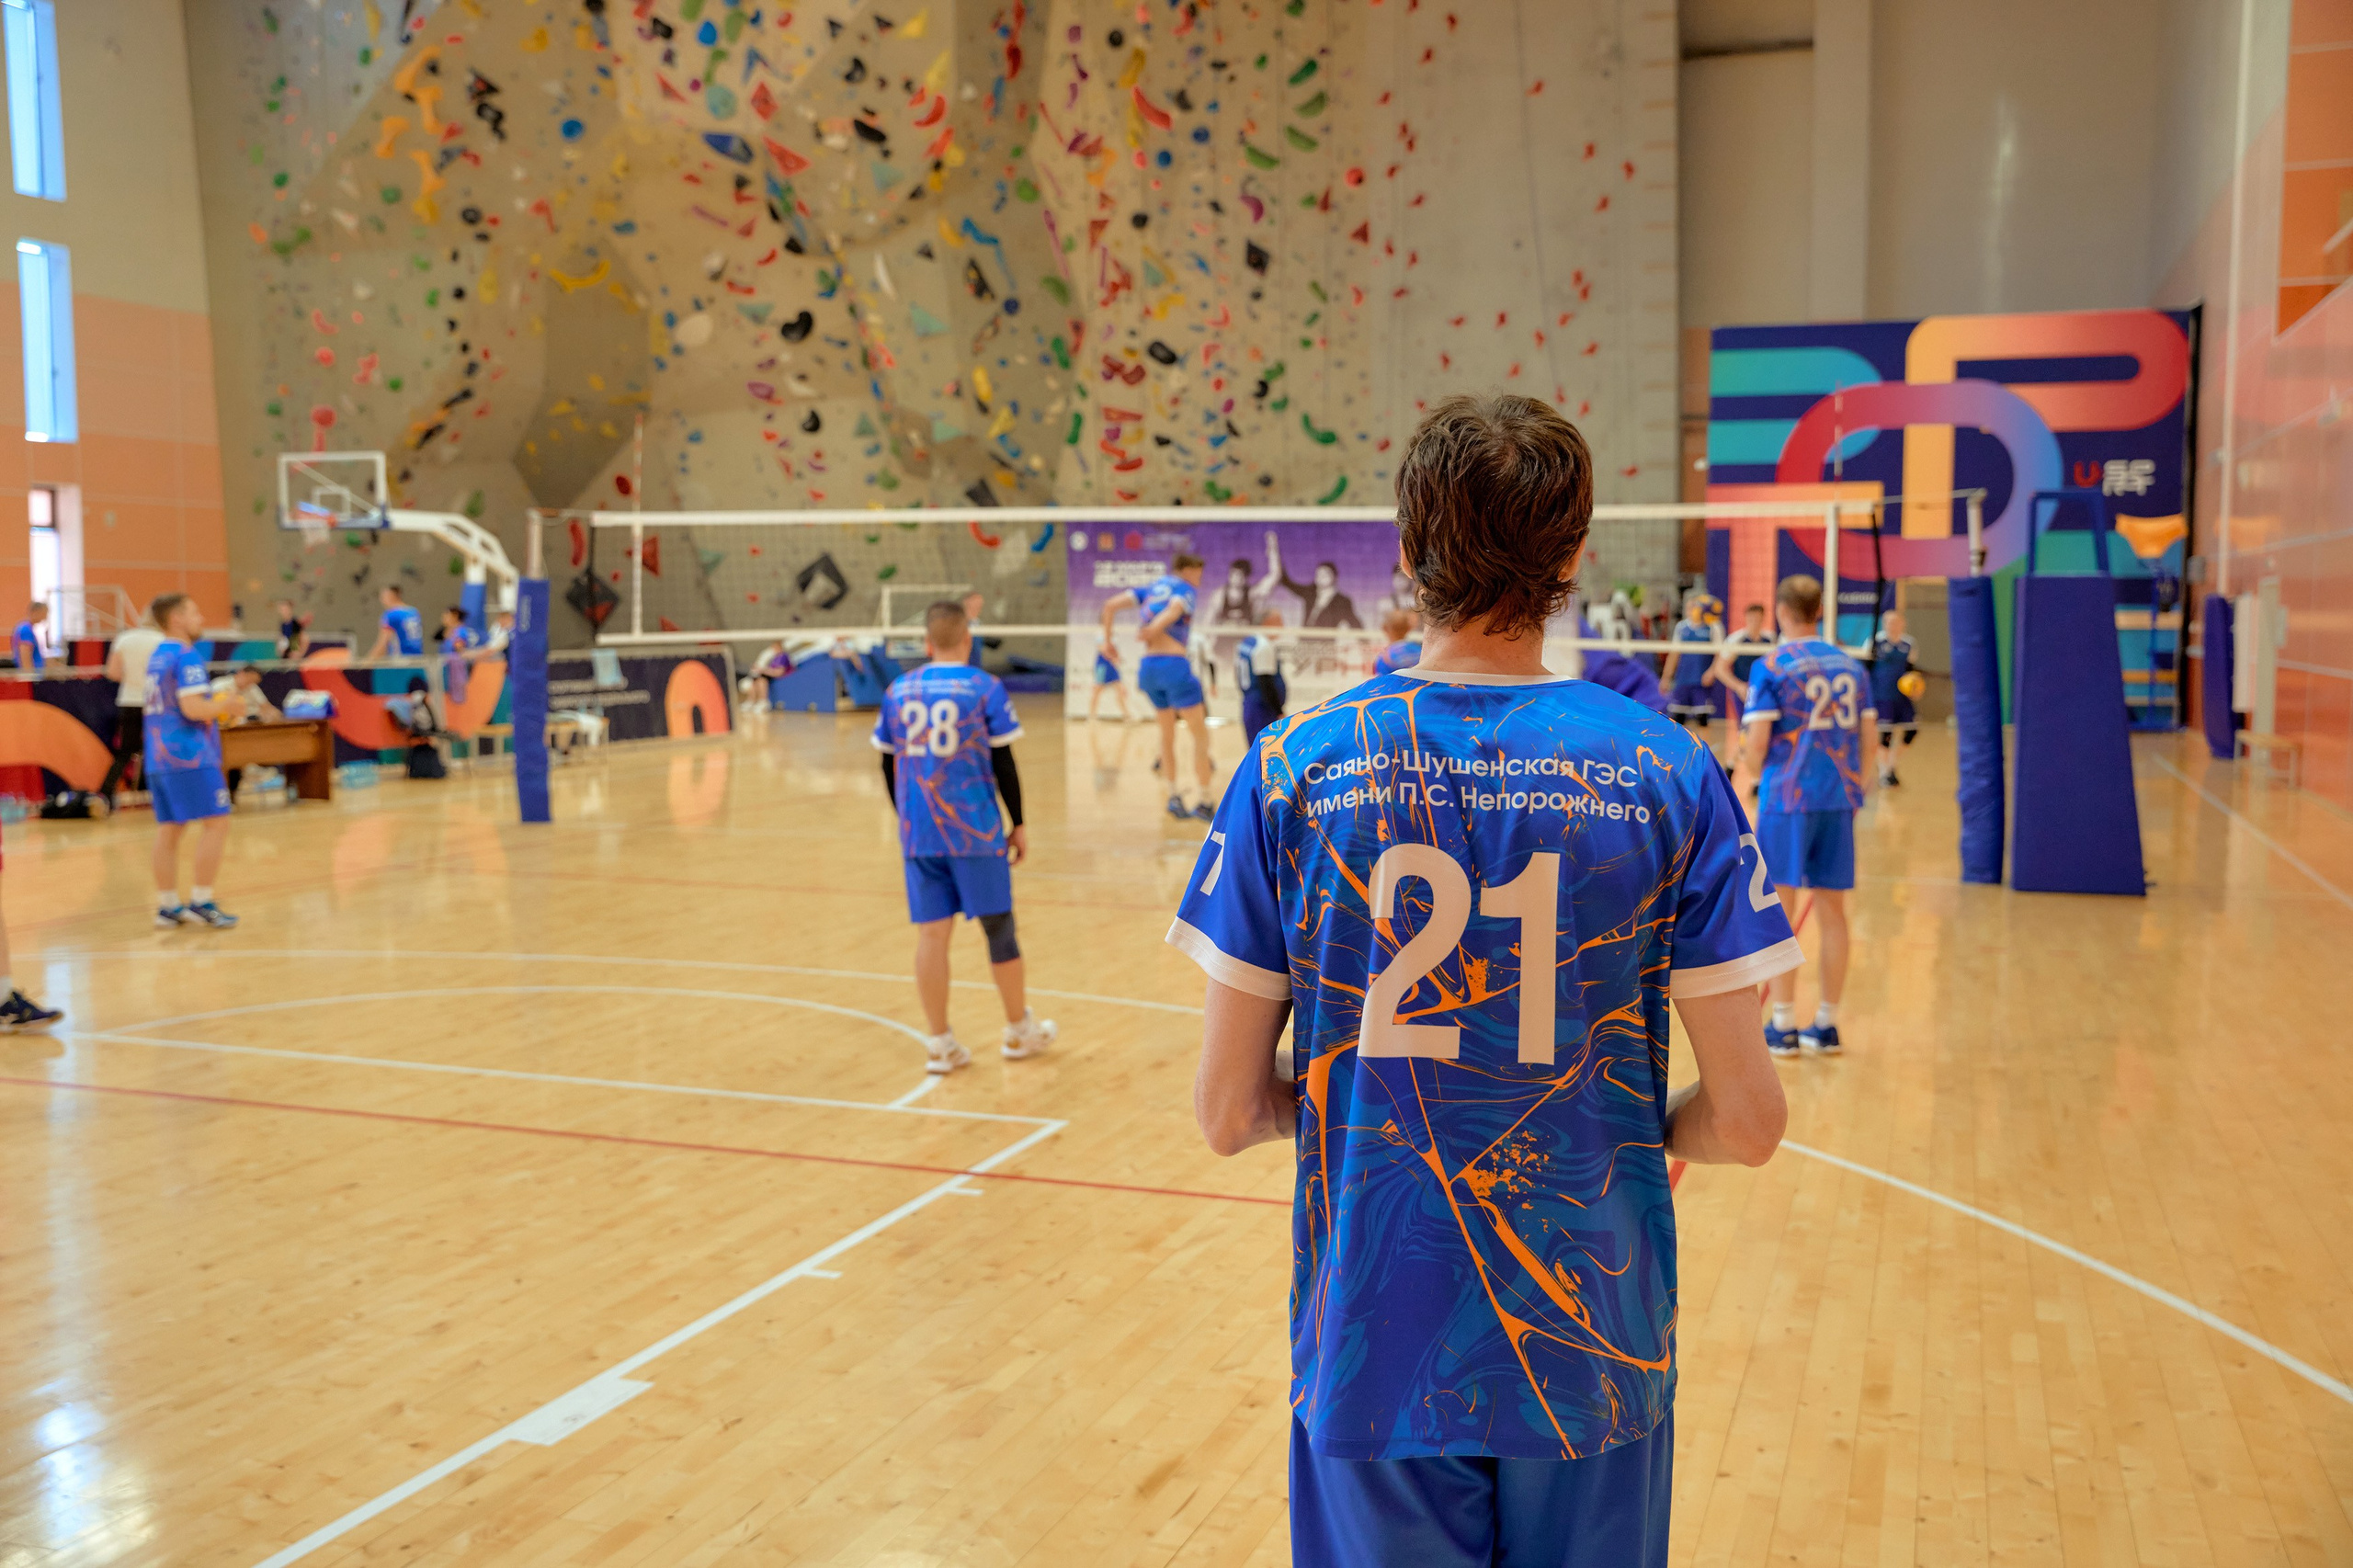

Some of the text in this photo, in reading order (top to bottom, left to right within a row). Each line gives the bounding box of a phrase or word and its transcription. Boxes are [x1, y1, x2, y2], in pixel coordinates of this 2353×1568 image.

[902, 699, 961, 758] 28
[1805, 673, 1858, 731] 23
[1303, 749, 1638, 788] Саяно-Шушенская ГЭС
[1306, 782, 1651, 824] имени П.С. Непорожнего
[1357, 843, 1561, 1066] 21
